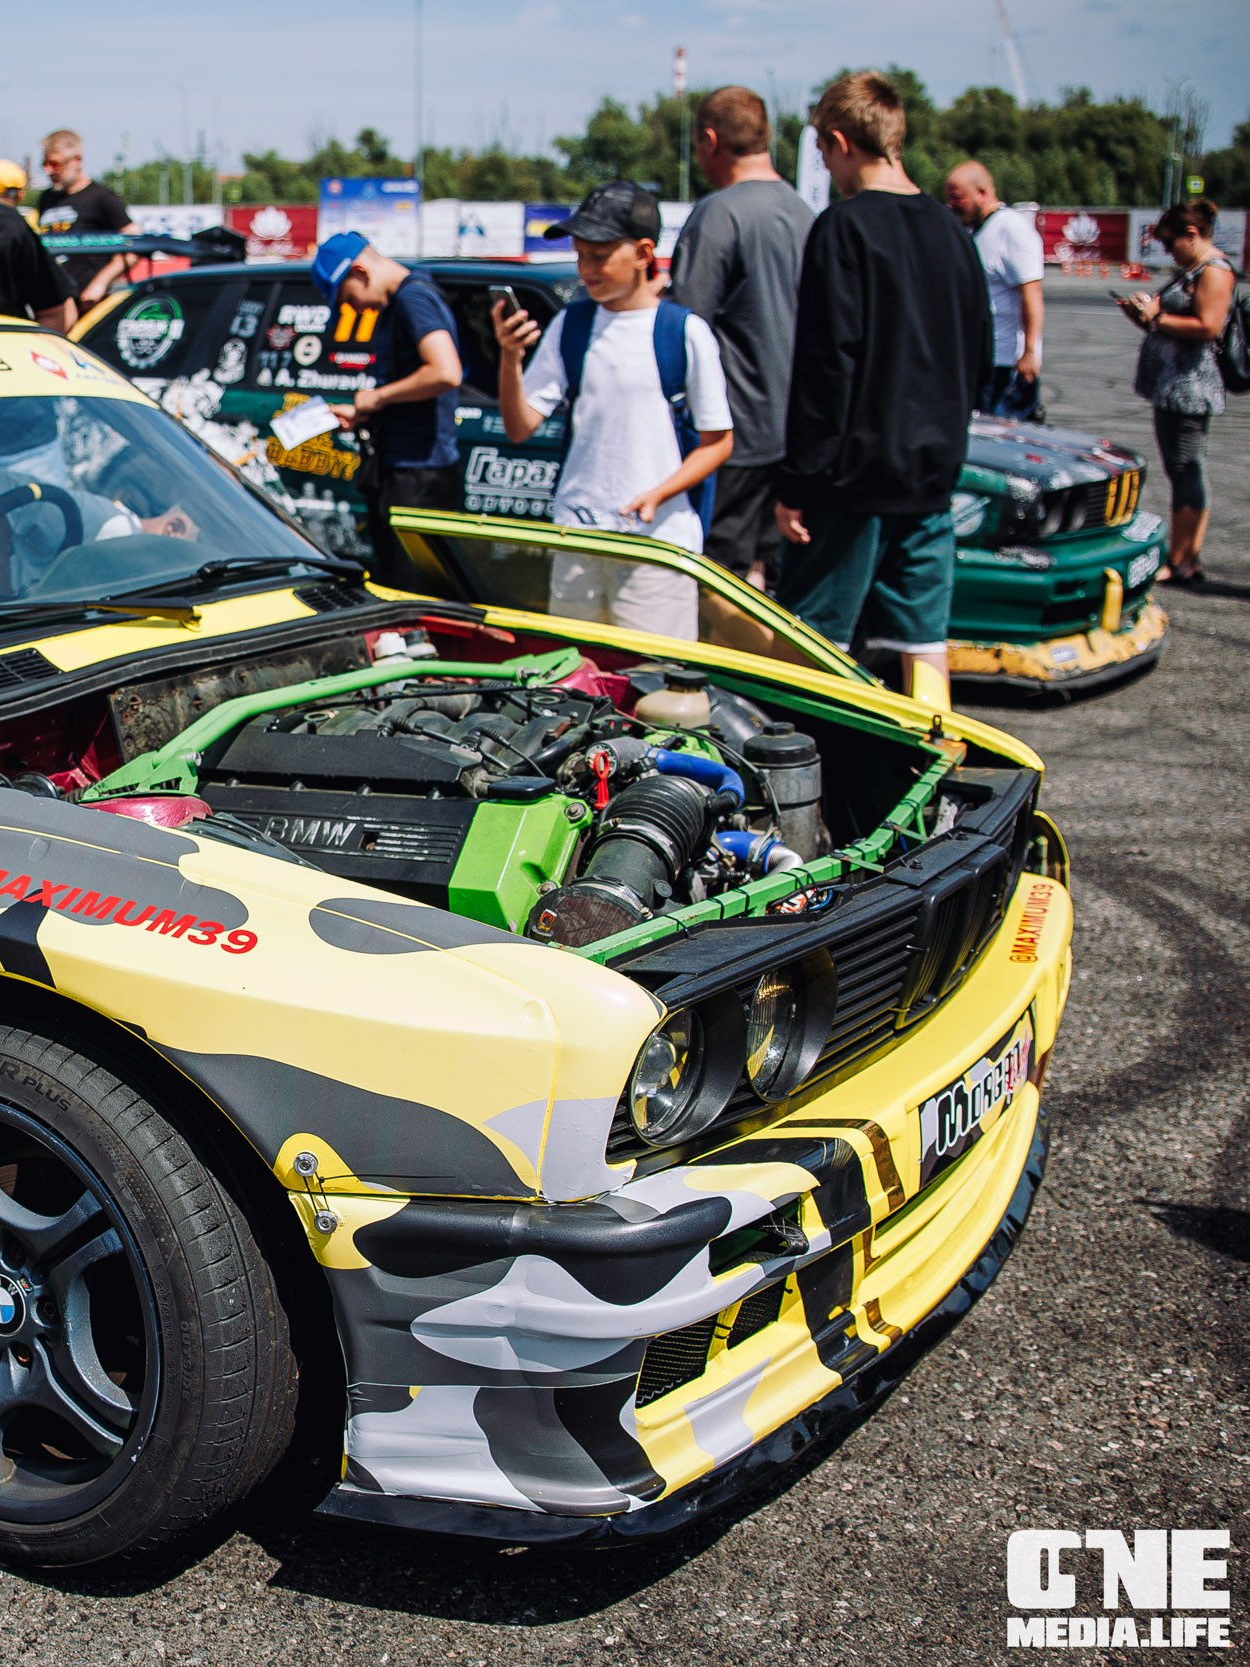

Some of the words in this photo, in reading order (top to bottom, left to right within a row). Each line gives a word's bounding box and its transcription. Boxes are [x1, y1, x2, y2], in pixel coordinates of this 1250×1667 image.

[263, 818, 357, 848] BMW
[1009, 884, 1054, 963] @MAXIMUM39
[22, 1076, 71, 1113] PLUS
